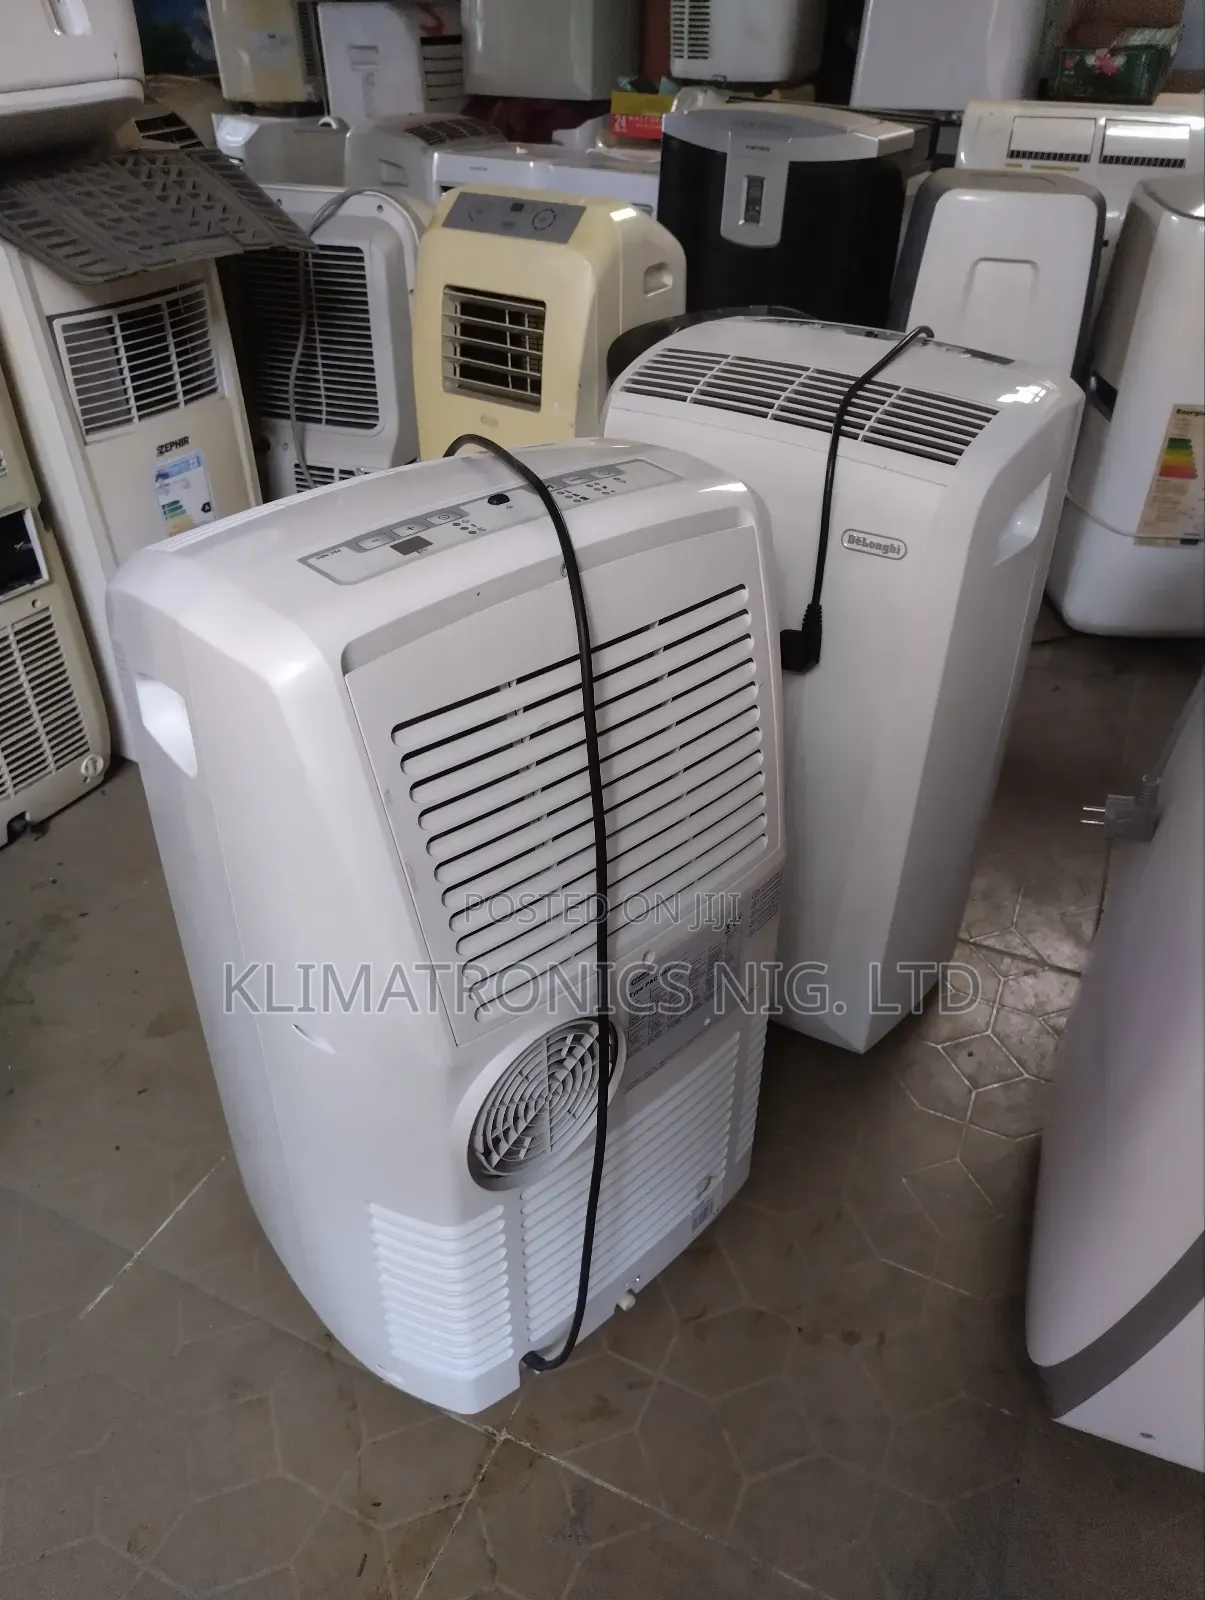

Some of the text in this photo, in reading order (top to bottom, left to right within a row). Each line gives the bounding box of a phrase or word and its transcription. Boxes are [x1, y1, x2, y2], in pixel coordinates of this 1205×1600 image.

[157, 436, 190, 454] ZEPHIR
[629, 986, 644, 998] Type
[645, 976, 658, 988] PAC
